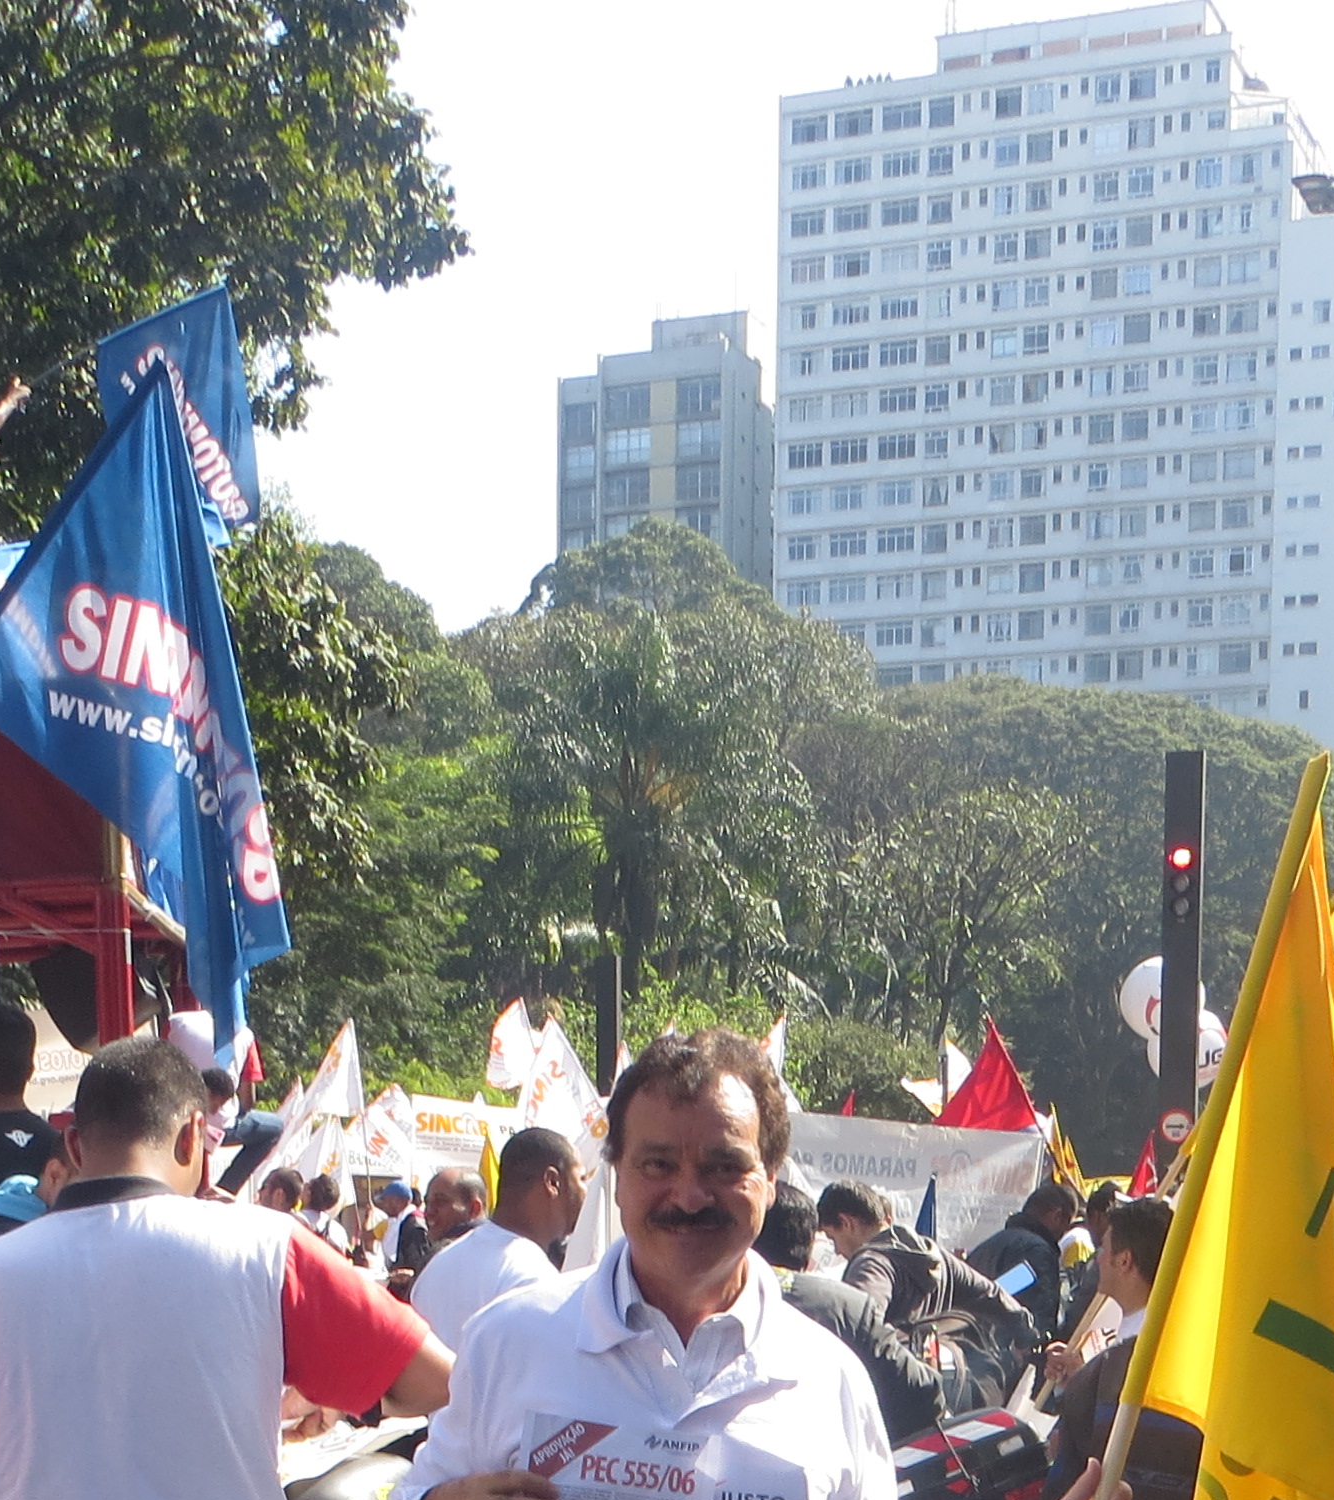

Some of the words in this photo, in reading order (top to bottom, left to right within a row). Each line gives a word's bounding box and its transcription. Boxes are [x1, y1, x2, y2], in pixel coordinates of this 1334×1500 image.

[532, 1422, 586, 1467] APROVAÇÃO
[580, 1454, 621, 1484] PEC
[624, 1460, 697, 1496] 555/06
